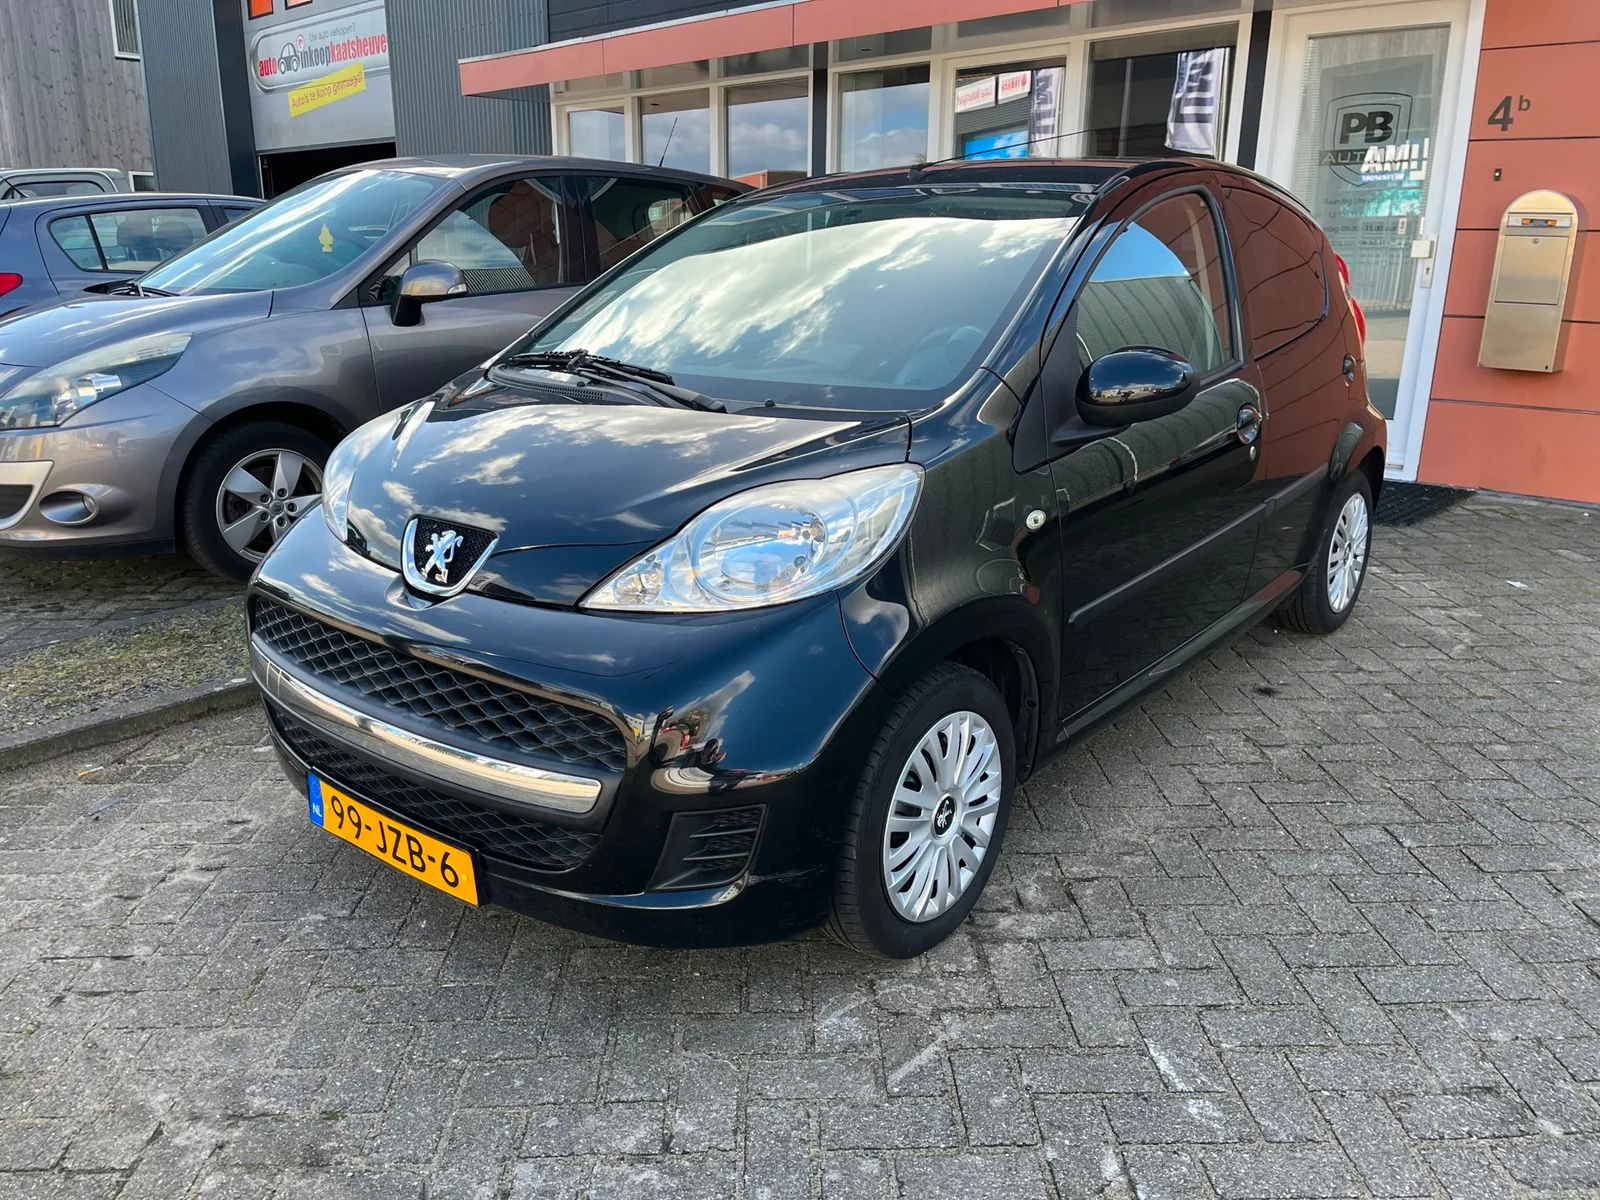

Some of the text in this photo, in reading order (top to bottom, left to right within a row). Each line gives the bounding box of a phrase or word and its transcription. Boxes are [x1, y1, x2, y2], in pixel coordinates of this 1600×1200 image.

[309, 22, 356, 42] Uw auto verkopen?
[291, 93, 310, 110] Auto's
[309, 91, 317, 102] te
[1340, 110, 1394, 144] PB
[1365, 224, 1384, 232] 15.00
[312, 805, 322, 818] NL
[331, 795, 459, 888] 99-JZB-6
